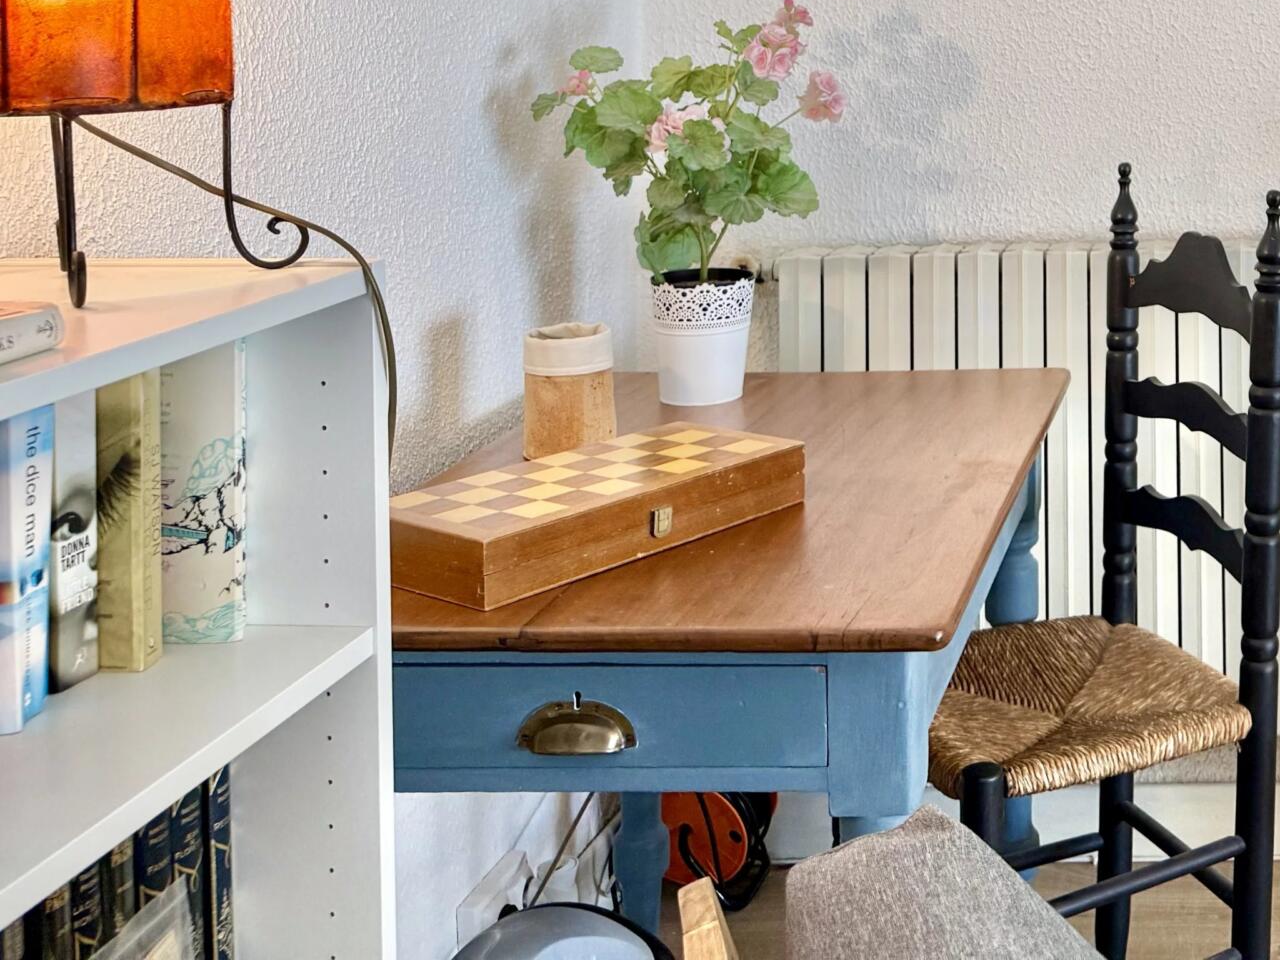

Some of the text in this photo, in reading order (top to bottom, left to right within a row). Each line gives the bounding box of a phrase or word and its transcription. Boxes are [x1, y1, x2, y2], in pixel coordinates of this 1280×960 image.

[25, 426, 41, 558] the dice man
[151, 475, 161, 557] WATSON
[61, 535, 90, 558] DONNA
[61, 549, 86, 572] TARTT
